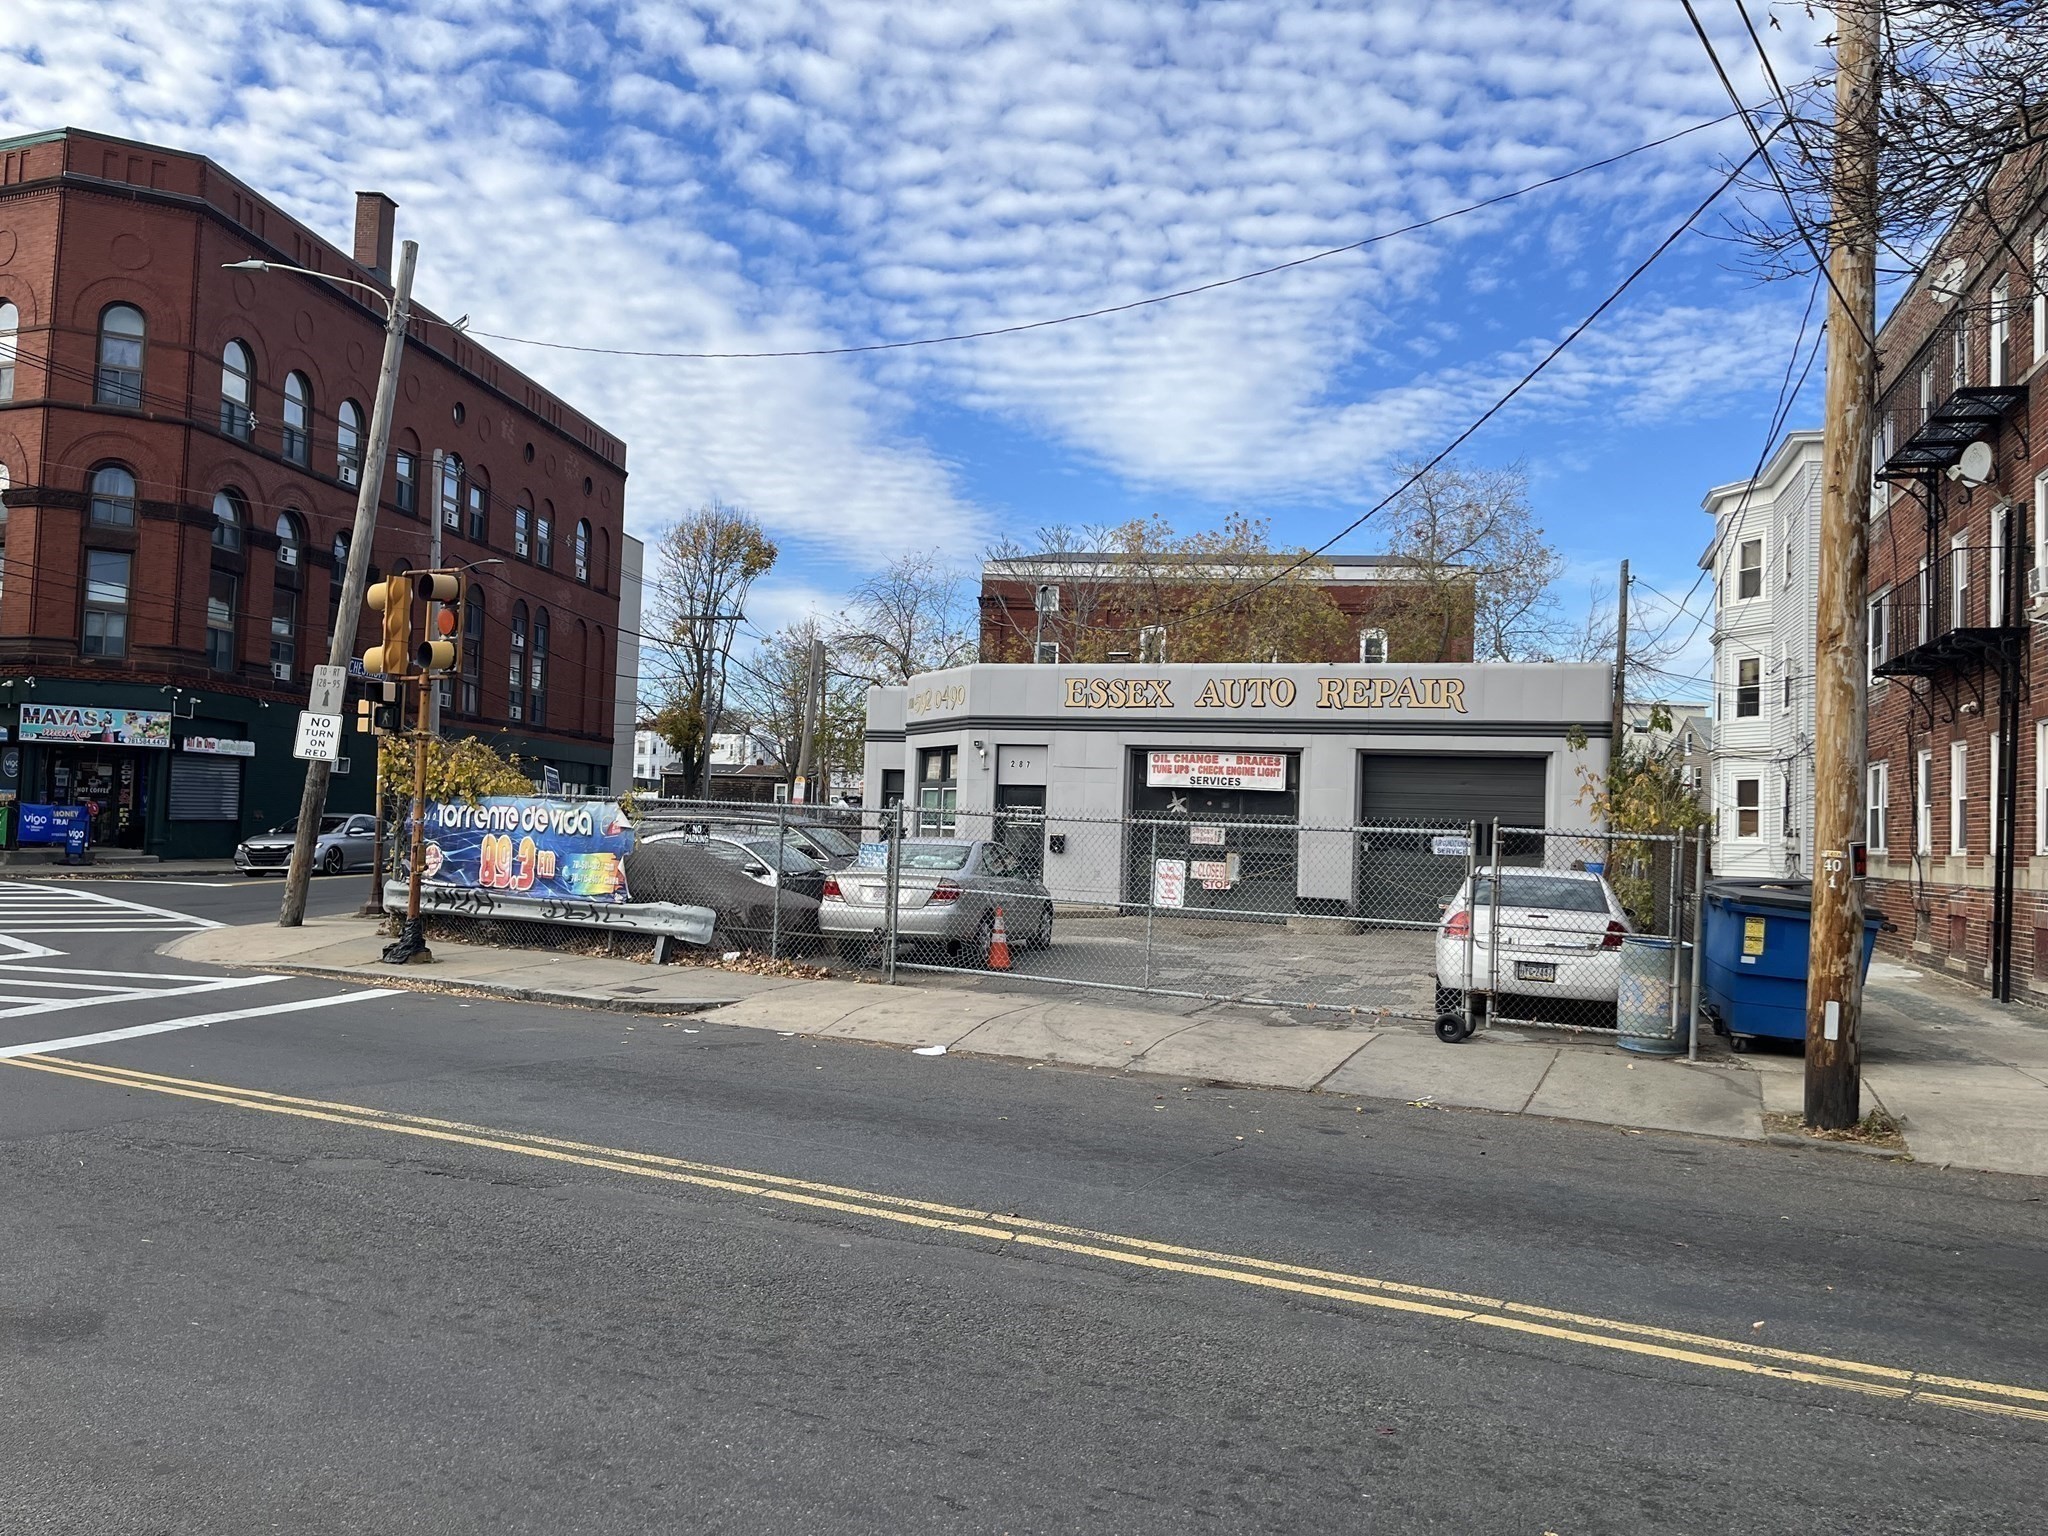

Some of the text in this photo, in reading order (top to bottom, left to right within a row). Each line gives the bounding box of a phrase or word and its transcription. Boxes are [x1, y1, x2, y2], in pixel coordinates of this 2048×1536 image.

[320, 667, 341, 677] TO RT
[316, 678, 341, 688] 128-95
[935, 684, 965, 710] 0490
[1064, 676, 1469, 713] ESSEX AUTO REPAIR
[22, 706, 98, 726] MAYAS
[311, 717, 331, 728] NO
[41, 725, 92, 742] market
[305, 728, 334, 738] TURN
[310, 738, 326, 747] ON
[304, 748, 327, 758] RED
[1152, 754, 1281, 766] OIL CHANGE BRAKES
[1151, 764, 1282, 778] TUNE UPS CHECK ENGINE LIGHT
[1189, 775, 1241, 786] SERVICES
[23, 813, 47, 825] vigo
[68, 828, 85, 840] vigo
[692, 824, 702, 833] NO
[479, 833, 537, 890] 89.3
[1824, 859, 1842, 872] 40
[1203, 880, 1230, 889] STOP
[1828, 874, 1836, 888] 1
